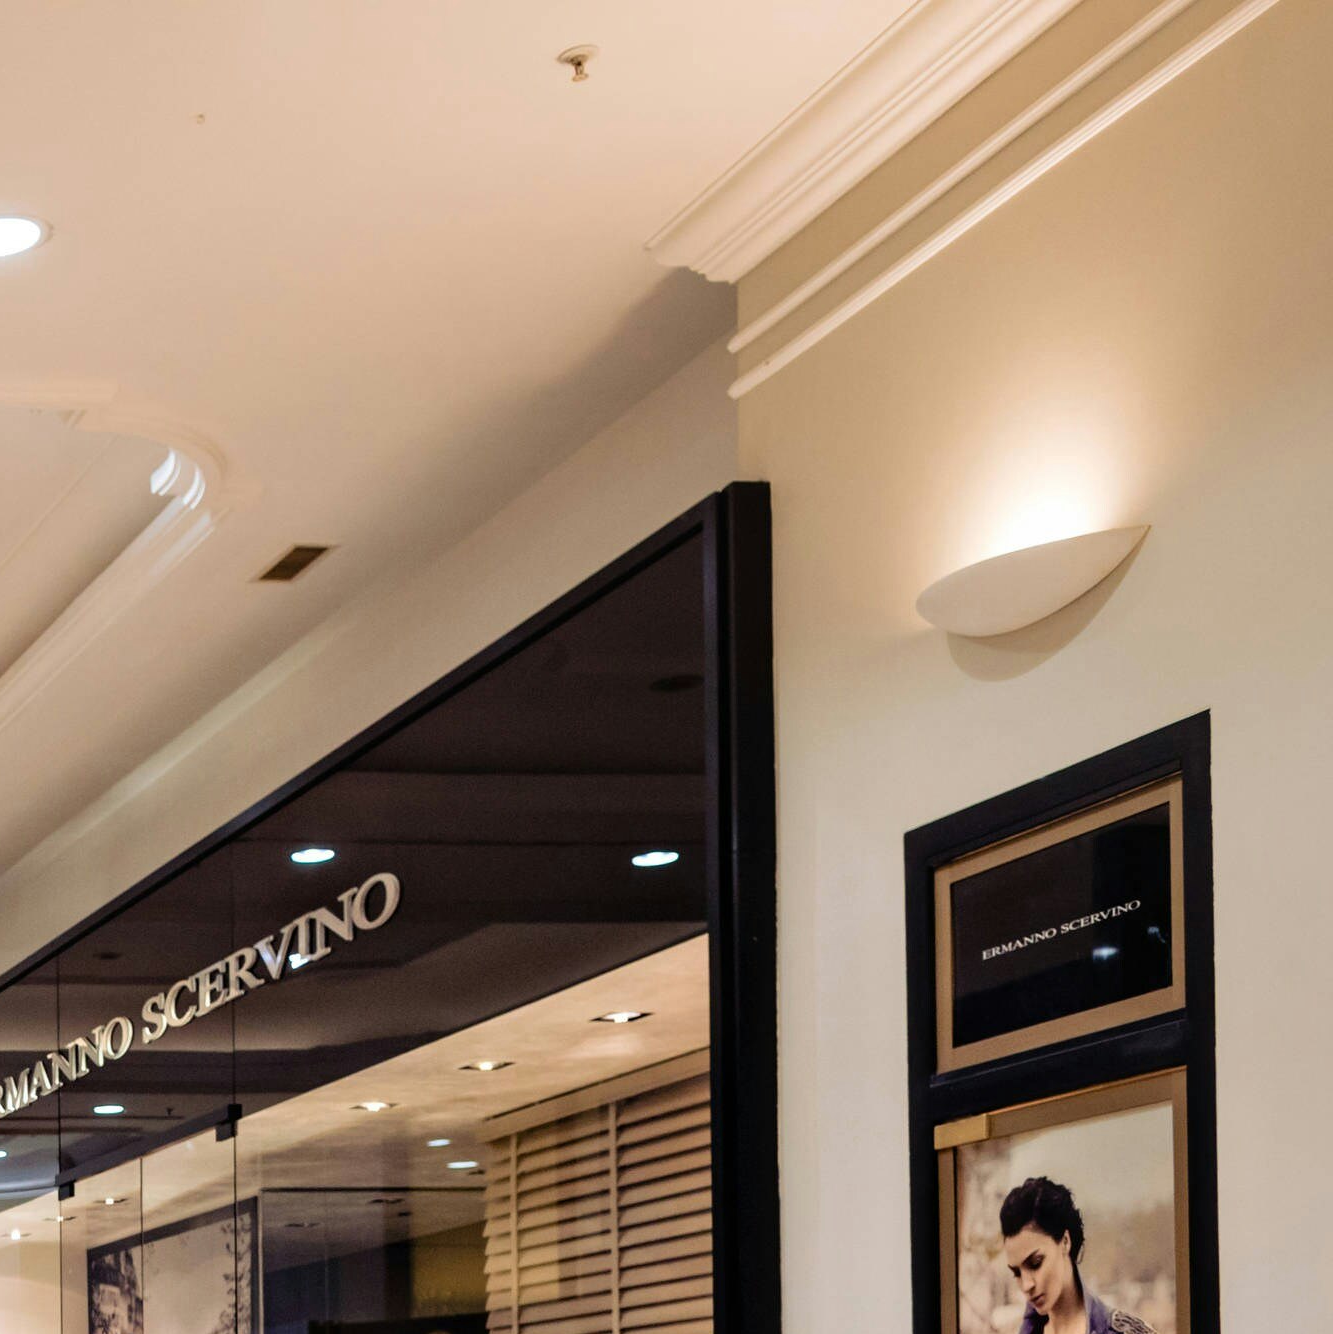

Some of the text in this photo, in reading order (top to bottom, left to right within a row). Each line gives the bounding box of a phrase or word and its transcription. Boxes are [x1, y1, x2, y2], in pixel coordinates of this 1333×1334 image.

[141, 872, 402, 1044] SCERVINO
[982, 900, 1141, 961] ERMANNO SCERVINO
